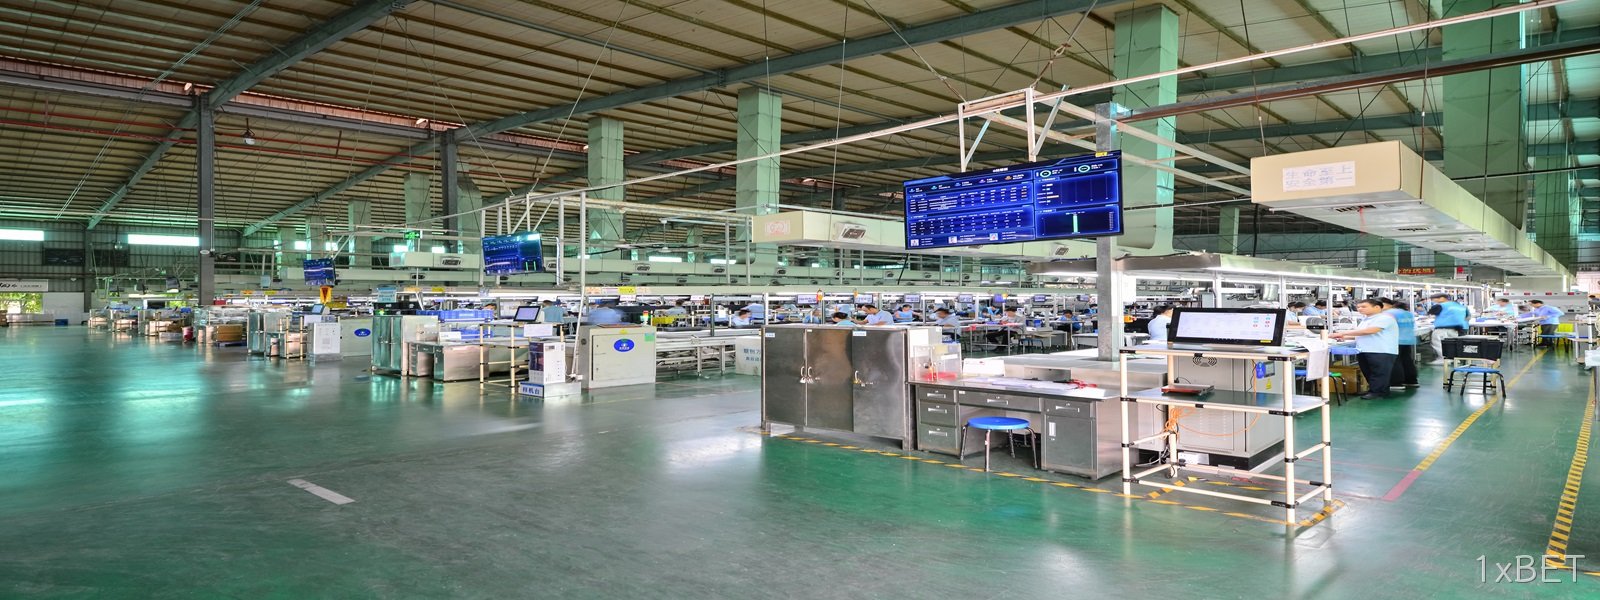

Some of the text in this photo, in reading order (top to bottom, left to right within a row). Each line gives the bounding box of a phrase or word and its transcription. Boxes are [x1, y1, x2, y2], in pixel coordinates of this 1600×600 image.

[1286, 165, 1353, 179] 生命至上
[1286, 176, 1353, 189] 安全第一
